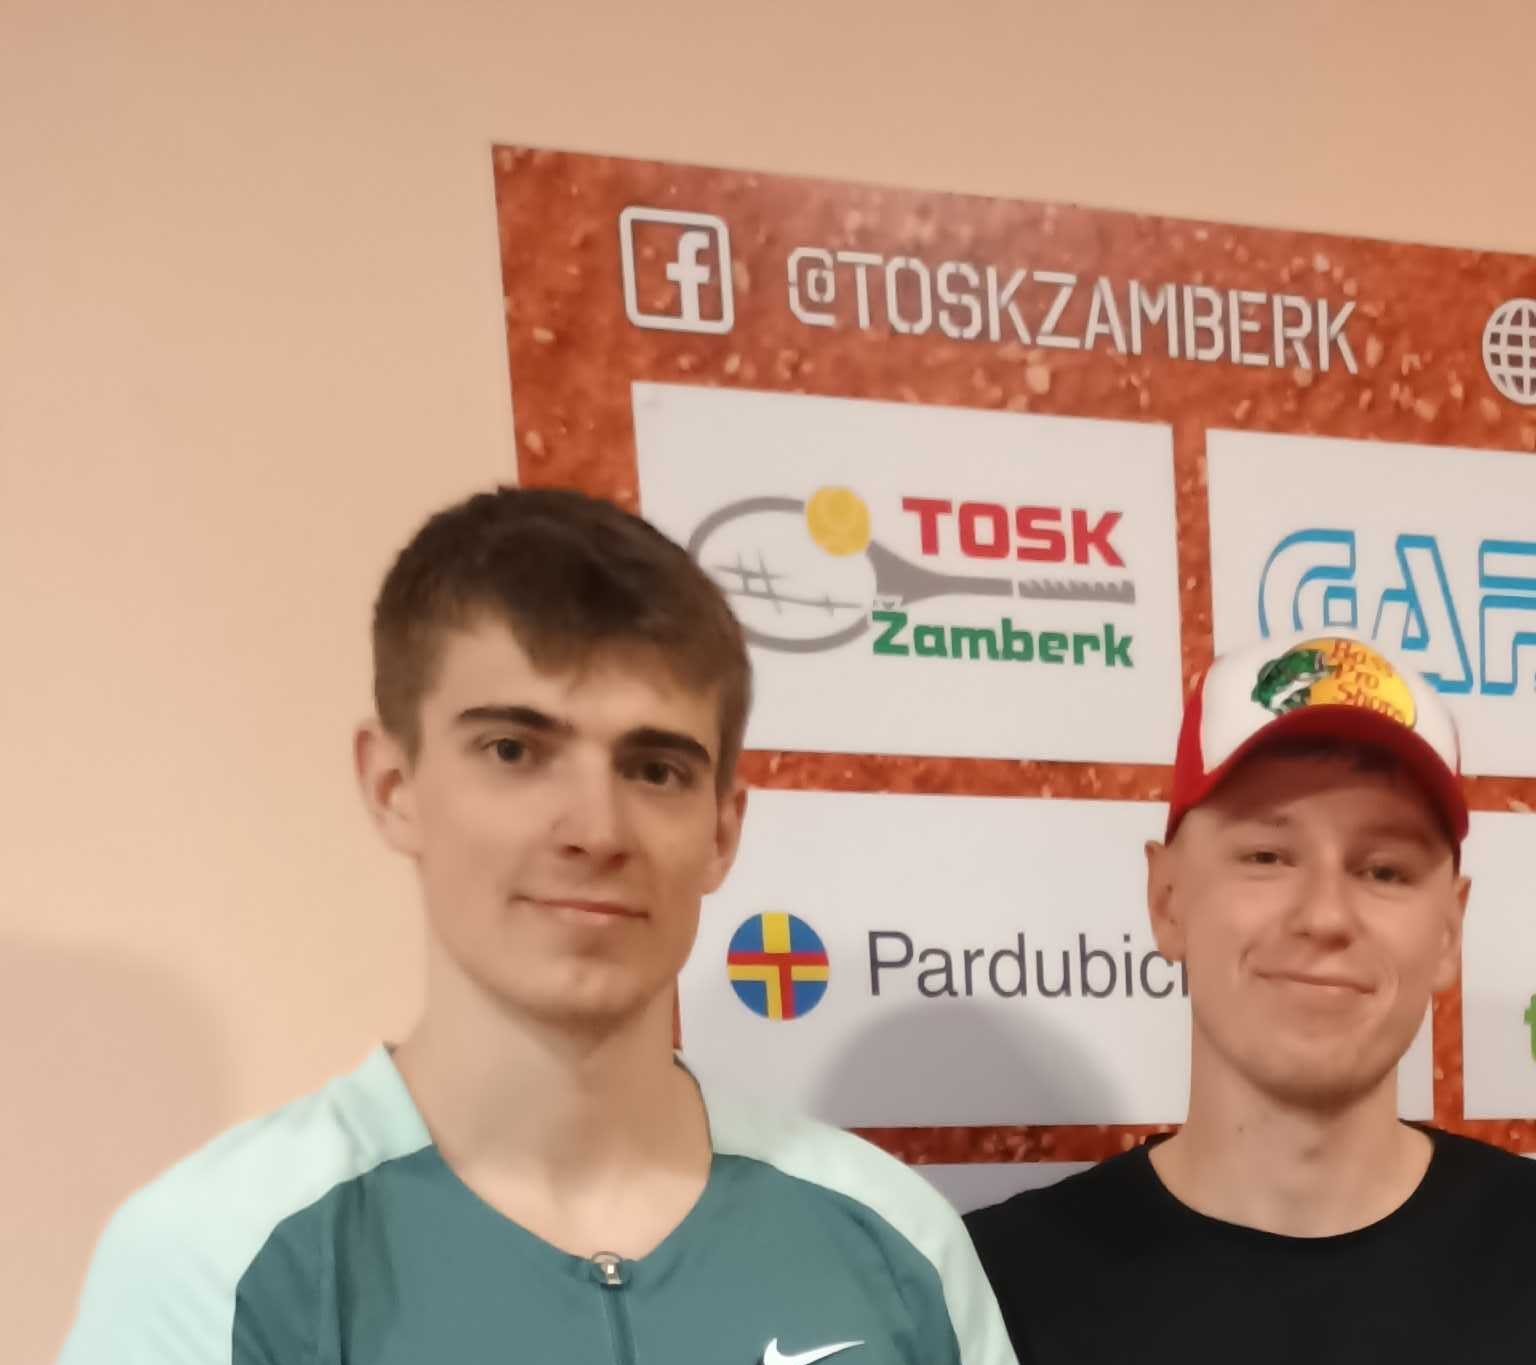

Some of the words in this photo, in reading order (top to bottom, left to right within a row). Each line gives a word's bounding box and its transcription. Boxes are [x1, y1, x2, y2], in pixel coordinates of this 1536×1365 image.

[787, 246, 1358, 375] @TOSKZAMBERK
[901, 496, 1126, 568] TOSK
[872, 600, 1135, 669] Žamberk
